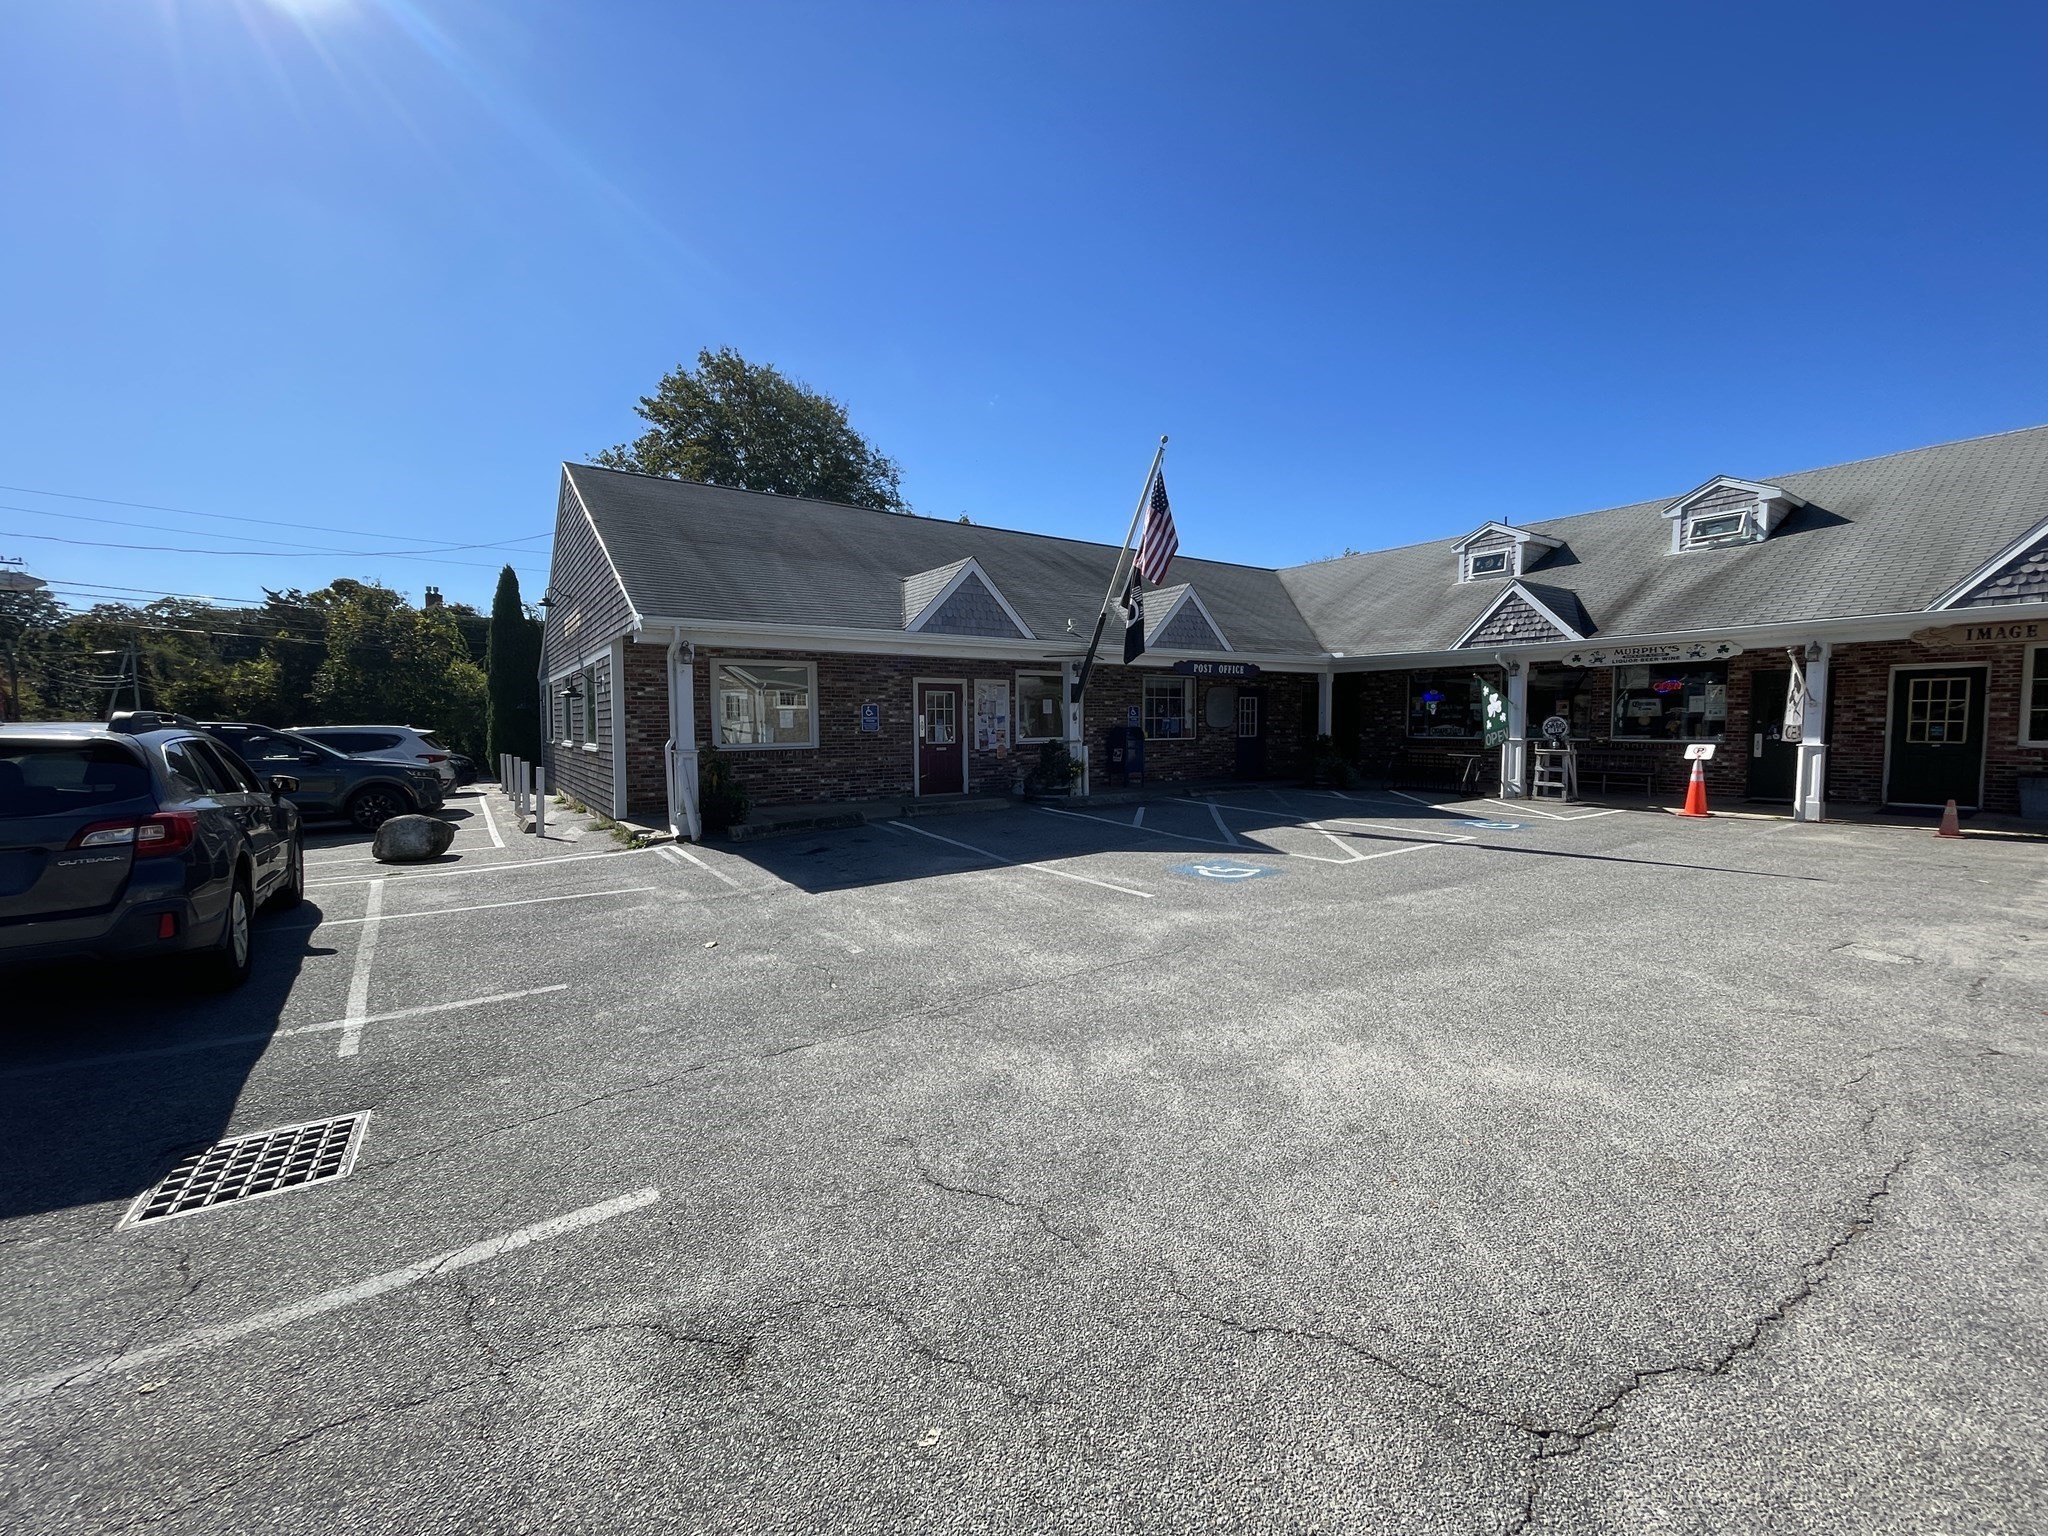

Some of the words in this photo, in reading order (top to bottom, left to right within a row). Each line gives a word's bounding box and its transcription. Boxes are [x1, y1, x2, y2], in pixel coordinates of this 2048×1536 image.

[1966, 624, 2038, 641] IMAGE
[1613, 645, 1680, 655] MURPHY'S
[1193, 663, 1213, 673] POST
[1218, 664, 1245, 674] OFFICE
[1485, 727, 1509, 746] OPEN
[57, 855, 122, 866] OUTBACK
